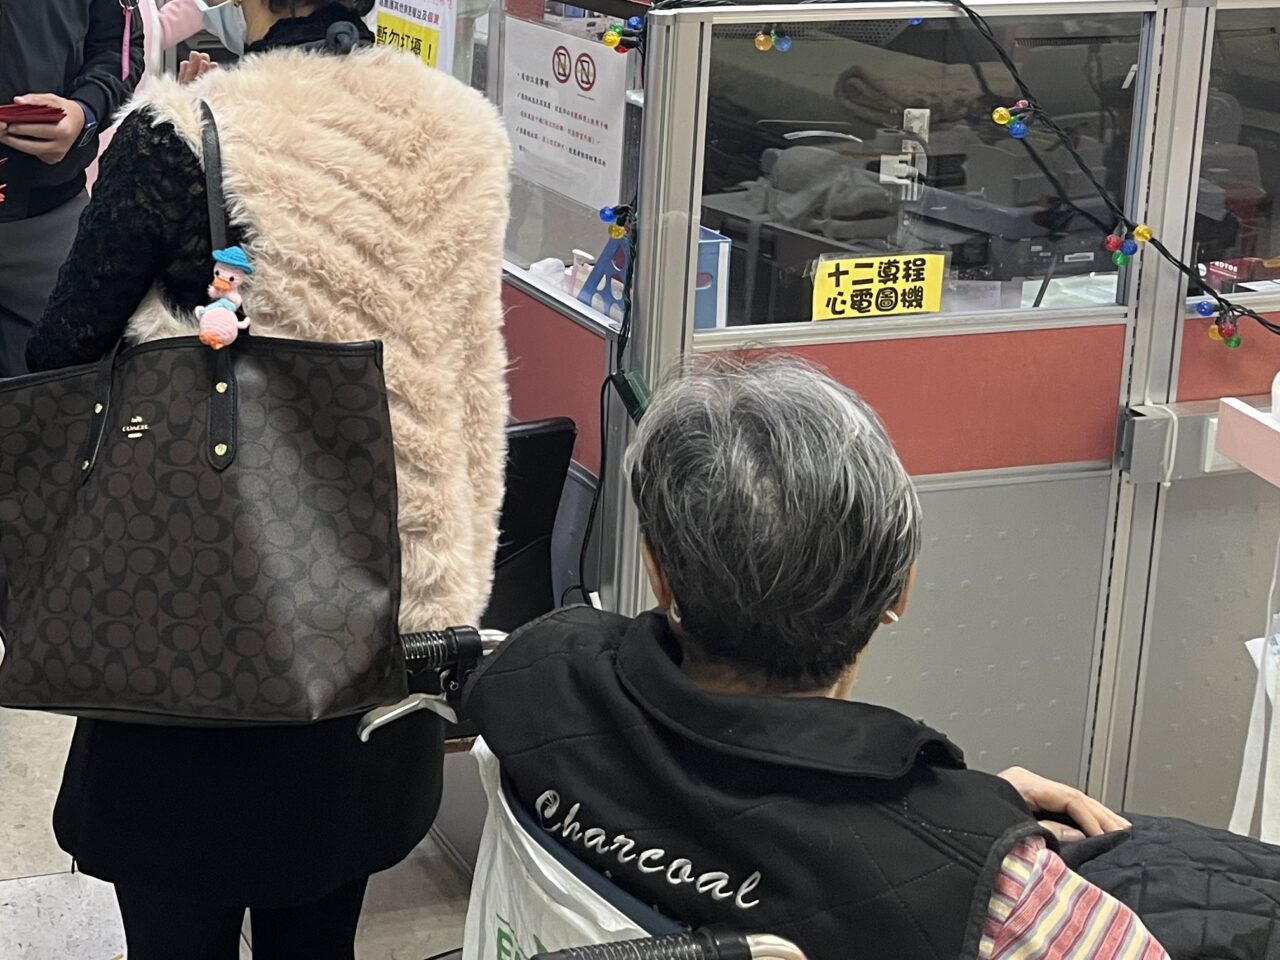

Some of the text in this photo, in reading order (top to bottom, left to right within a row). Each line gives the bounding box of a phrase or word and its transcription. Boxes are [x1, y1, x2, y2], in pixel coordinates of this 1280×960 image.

[827, 257, 926, 288] 十二導程
[825, 285, 924, 315] 心電圖機
[535, 789, 762, 909] Charcoal
